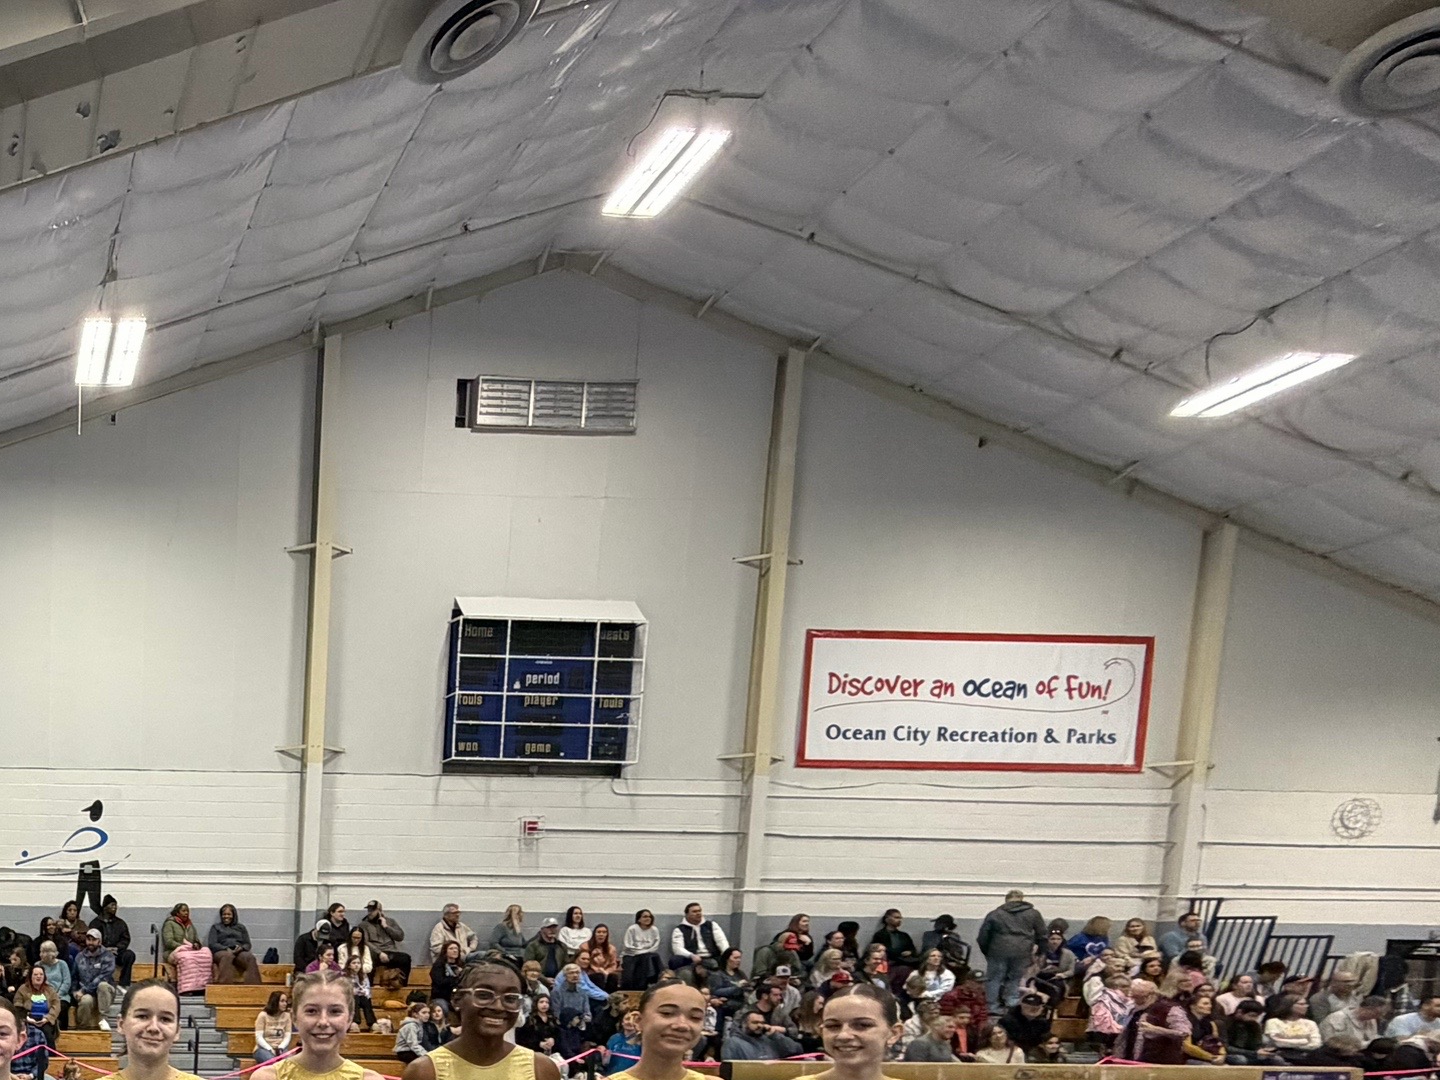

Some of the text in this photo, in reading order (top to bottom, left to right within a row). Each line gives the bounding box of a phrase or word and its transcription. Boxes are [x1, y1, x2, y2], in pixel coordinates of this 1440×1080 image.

[464, 623, 494, 637] Home
[525, 672, 560, 685] period
[827, 671, 925, 698] Discover
[929, 679, 955, 699] an
[962, 678, 1028, 699] ocean
[1035, 675, 1060, 699] of
[523, 694, 558, 707] player
[825, 724, 1117, 746] Ocean City Recreation & Parks
[458, 740, 479, 752] won
[524, 742, 552, 755] game
